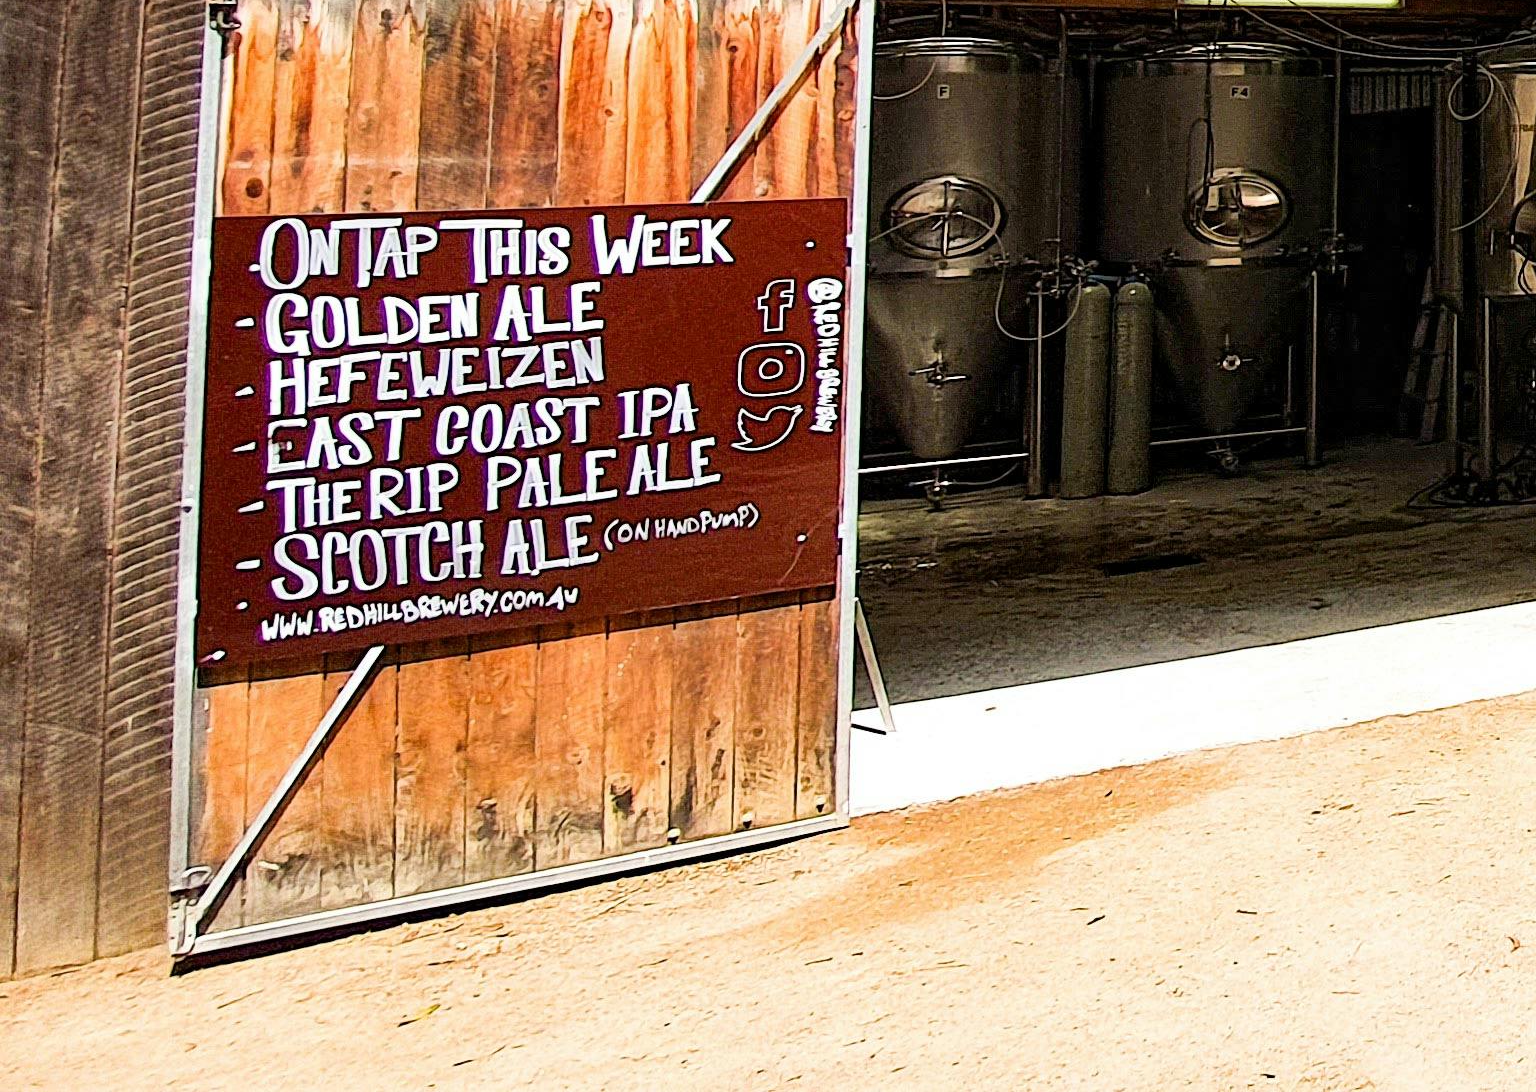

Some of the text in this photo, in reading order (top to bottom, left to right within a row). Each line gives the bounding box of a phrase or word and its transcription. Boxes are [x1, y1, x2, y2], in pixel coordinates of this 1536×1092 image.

[259, 214, 734, 290] ON TAP THIS WEEK
[264, 281, 604, 357] GOLDEN ALE
[267, 336, 605, 416] HEFEWEIZEN
[266, 382, 700, 474] EAST COAST IPA
[265, 436, 721, 534] THE RIP PALE ALE
[270, 519, 485, 601] SCOTCH
[500, 514, 599, 577] ALE
